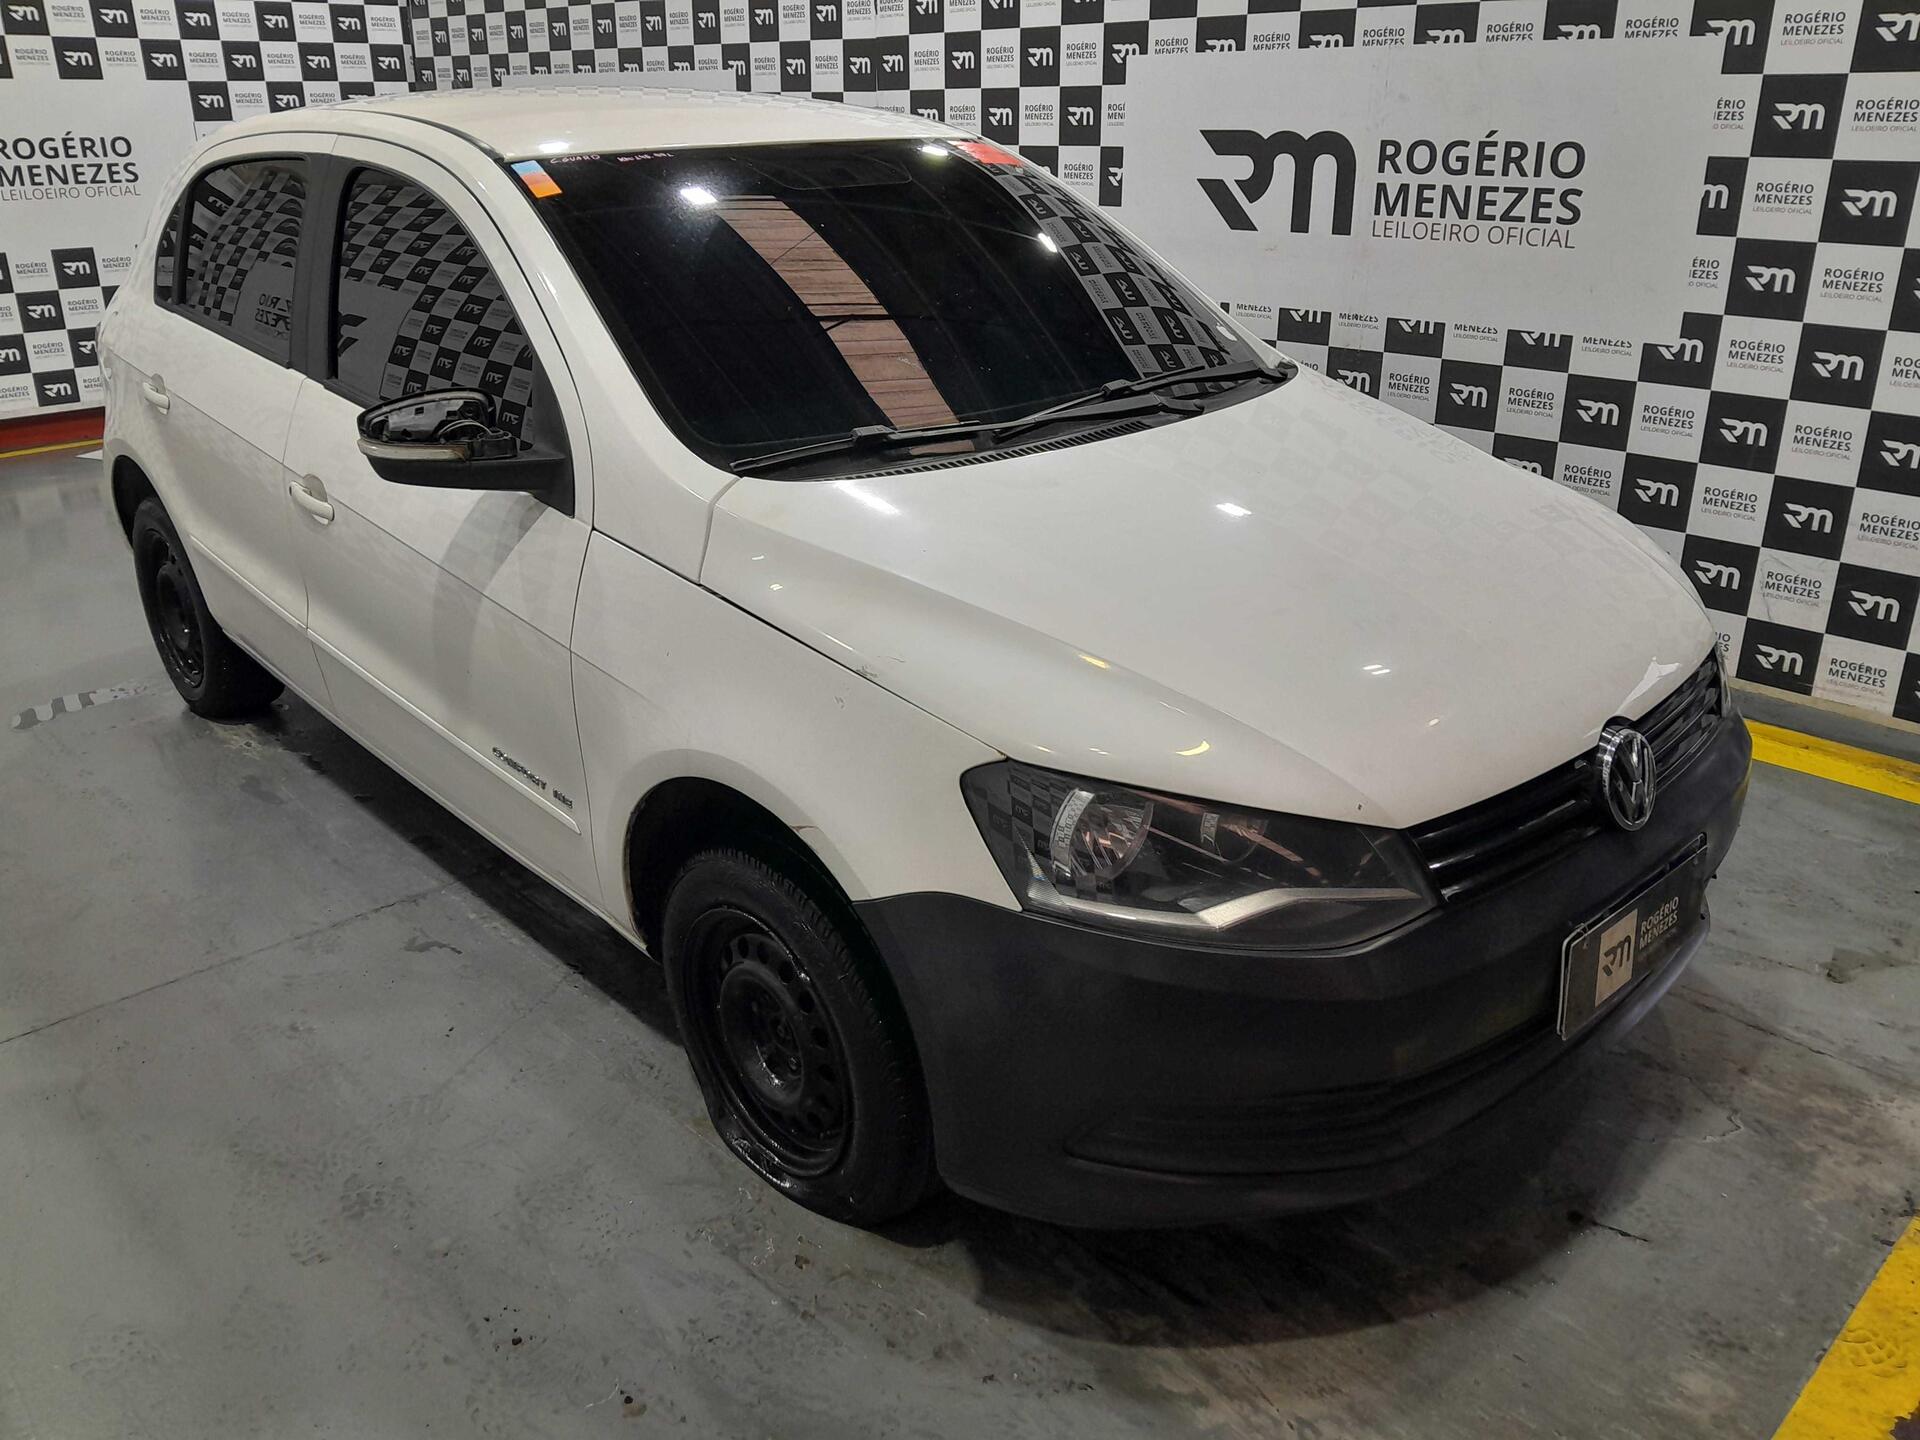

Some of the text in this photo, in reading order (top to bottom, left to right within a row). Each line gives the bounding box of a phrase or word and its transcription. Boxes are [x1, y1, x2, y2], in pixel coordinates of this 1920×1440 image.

[724, 7, 745, 15] ROGÉRIO
[782, 3, 806, 11] ROGÉRIO
[724, 14, 745, 22] MENEZES
[783, 10, 806, 19] MENEZES
[1784, 9, 1846, 24] ROGÉRIO
[1487, 21, 1534, 33] ROGÉRIO
[1626, 16, 1679, 29] ROGÉRIO
[1253, 31, 1291, 42] ROGÉRIO
[1363, 25, 1405, 38] ROGÉRIO
[1782, 24, 1845, 36] MENEZES
[1066, 41, 1097, 51] ROGÉRIO
[1155, 36, 1189, 47] ROGÉRIO
[914, 49, 940, 58] ROGÉRIO
[986, 45, 1014, 55] ROGÉRIO
[1066, 50, 1097, 60] MENEZES
[754, 56, 776, 64] ROGÉRIO
[815, 55, 838, 63] ROGÉRIO
[914, 57, 940, 66] MENEZES
[986, 54, 1015, 63] MENEZES
[754, 62, 776, 71] MENEZES
[815, 61, 839, 70] MENEZES
[949, 104, 976, 113] ROGÉRIO
[1025, 102, 1054, 112] ROGÉRIO
[1855, 97, 1920, 111] ROGÉRIO
[950, 112, 976, 121] MENEZES
[1025, 112, 1054, 121] MENEZES
[1853, 111, 1918, 123] MENEZES
[1377, 130, 1586, 179] ROGÉRIO
[1064, 161, 1094, 172] ROGÉRIO
[0, 162, 139, 187] MENEZES
[1064, 170, 1094, 180] MENEZES
[1, 185, 141, 200] LEILOEIRO OFICIAL
[1756, 181, 1814, 194] ROGÉRIO
[1374, 182, 1584, 226] MENEZES
[1754, 193, 1813, 206] MENEZES
[1372, 219, 1576, 249] LEILOEIRO OFICIAL
[16, 267, 48, 275] MENEZES
[1823, 267, 1885, 281] ROGÉRIO
[1822, 279, 1883, 293] MENEZES
[67, 298, 98, 306] ROGÉRIO
[32, 341, 64, 350] ROGÉRIO
[34, 347, 65, 356] MENEZES
[1729, 338, 1786, 354] ROGÉRIO
[1728, 350, 1784, 364] MENEZES
[1389, 372, 1430, 385] ROGÉRIO
[1388, 382, 1430, 395] MENEZES
[1508, 387, 1555, 401] ROGÉRIO
[1507, 397, 1554, 411] MENEZES
[1643, 404, 1695, 420] ROGÉRIO
[1641, 414, 1694, 430] MENEZES
[1795, 424, 1853, 441] ROGÉRIO
[1793, 435, 1851, 451] MENEZES
[1564, 463, 1612, 479] ROGÉRIO
[1562, 473, 1611, 489] MENEZES
[1704, 485, 1758, 503] ROGÉRIO
[1702, 496, 1756, 513] MENEZES
[1862, 512, 1920, 531] ROGÉRIO
[1859, 523, 1919, 542] MENEZES
[1767, 570, 1822, 589] ROGÉRIO
[1765, 581, 1821, 600] MENEZES
[1830, 657, 1888, 678] ROGÉRIO
[1828, 668, 1886, 689] MENEZES
[1640, 896, 1679, 934] ROGÉRIO
[1640, 910, 1678, 949] MENEZES
